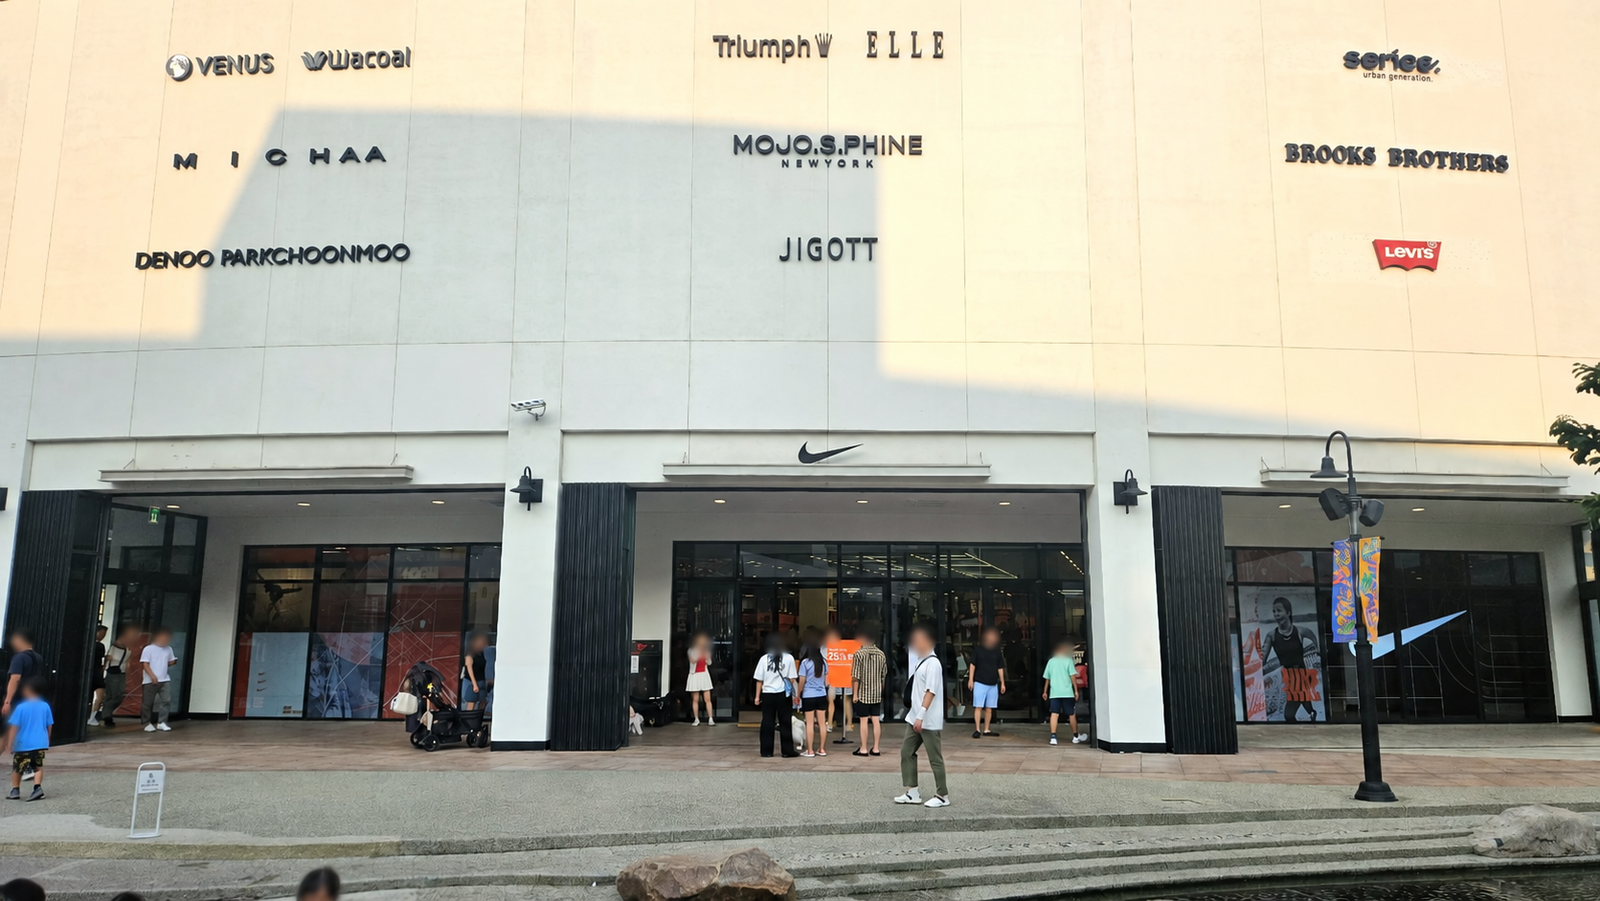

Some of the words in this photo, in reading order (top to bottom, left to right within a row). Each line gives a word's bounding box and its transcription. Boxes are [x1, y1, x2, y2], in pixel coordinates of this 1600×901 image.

[713, 34, 810, 64] Triumph
[867, 31, 944, 59] ELLE
[196, 53, 274, 76] VENUS
[328, 47, 411, 71] Wacoal
[1363, 71, 1386, 79] urban
[733, 135, 923, 156] MOJO.S.PHINE
[1285, 143, 1376, 166] BROOKS
[1388, 148, 1510, 174] BROTHERS
[135, 250, 214, 270] DENOO
[221, 243, 411, 268] PARKCHOONMOO
[779, 237, 879, 262] JIGOTT
